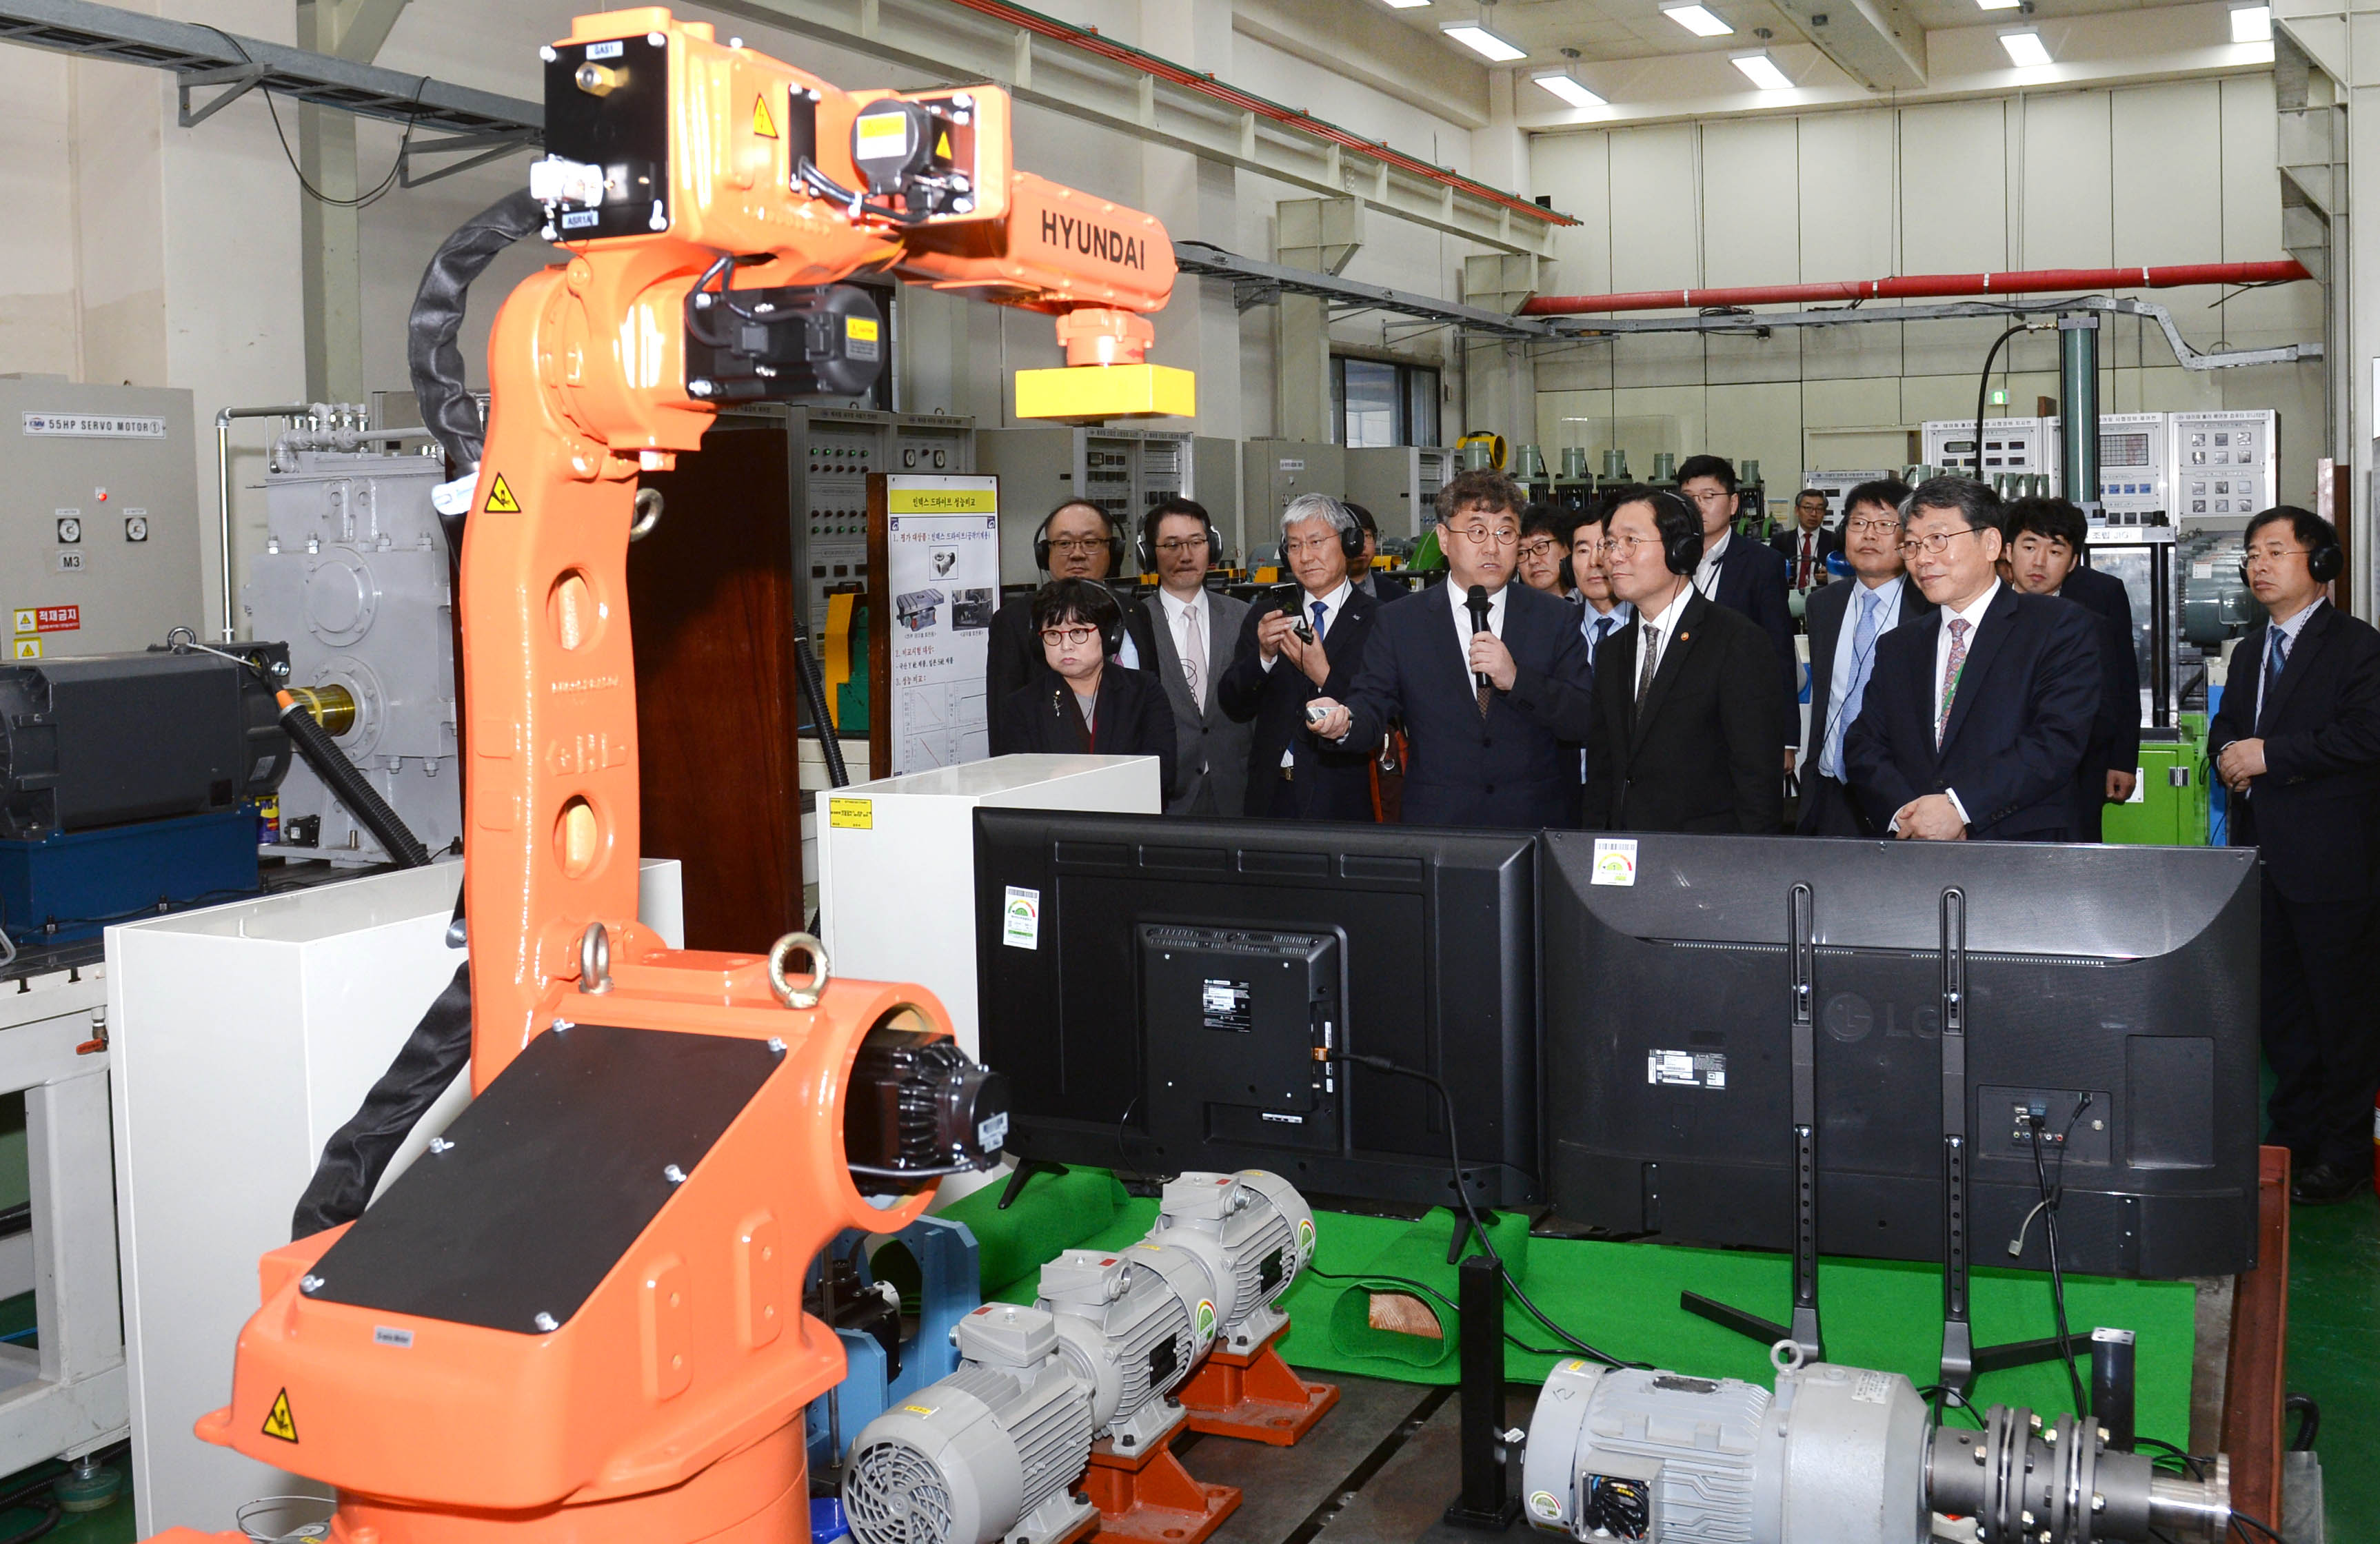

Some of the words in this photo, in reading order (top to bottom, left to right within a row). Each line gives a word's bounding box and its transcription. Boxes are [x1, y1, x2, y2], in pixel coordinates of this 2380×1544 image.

[1042, 209, 1144, 270] HYUNDAI
[49, 419, 75, 429] 55HP
[81, 420, 112, 431] SERVO
[913, 497, 929, 507] 인덱스
[931, 496, 952, 507] 드라이브
[954, 497, 976, 507] 성능비교
[2092, 531, 2110, 540] 조립
[63, 556, 80, 568] M3
[39, 609, 77, 622] 적재금지
